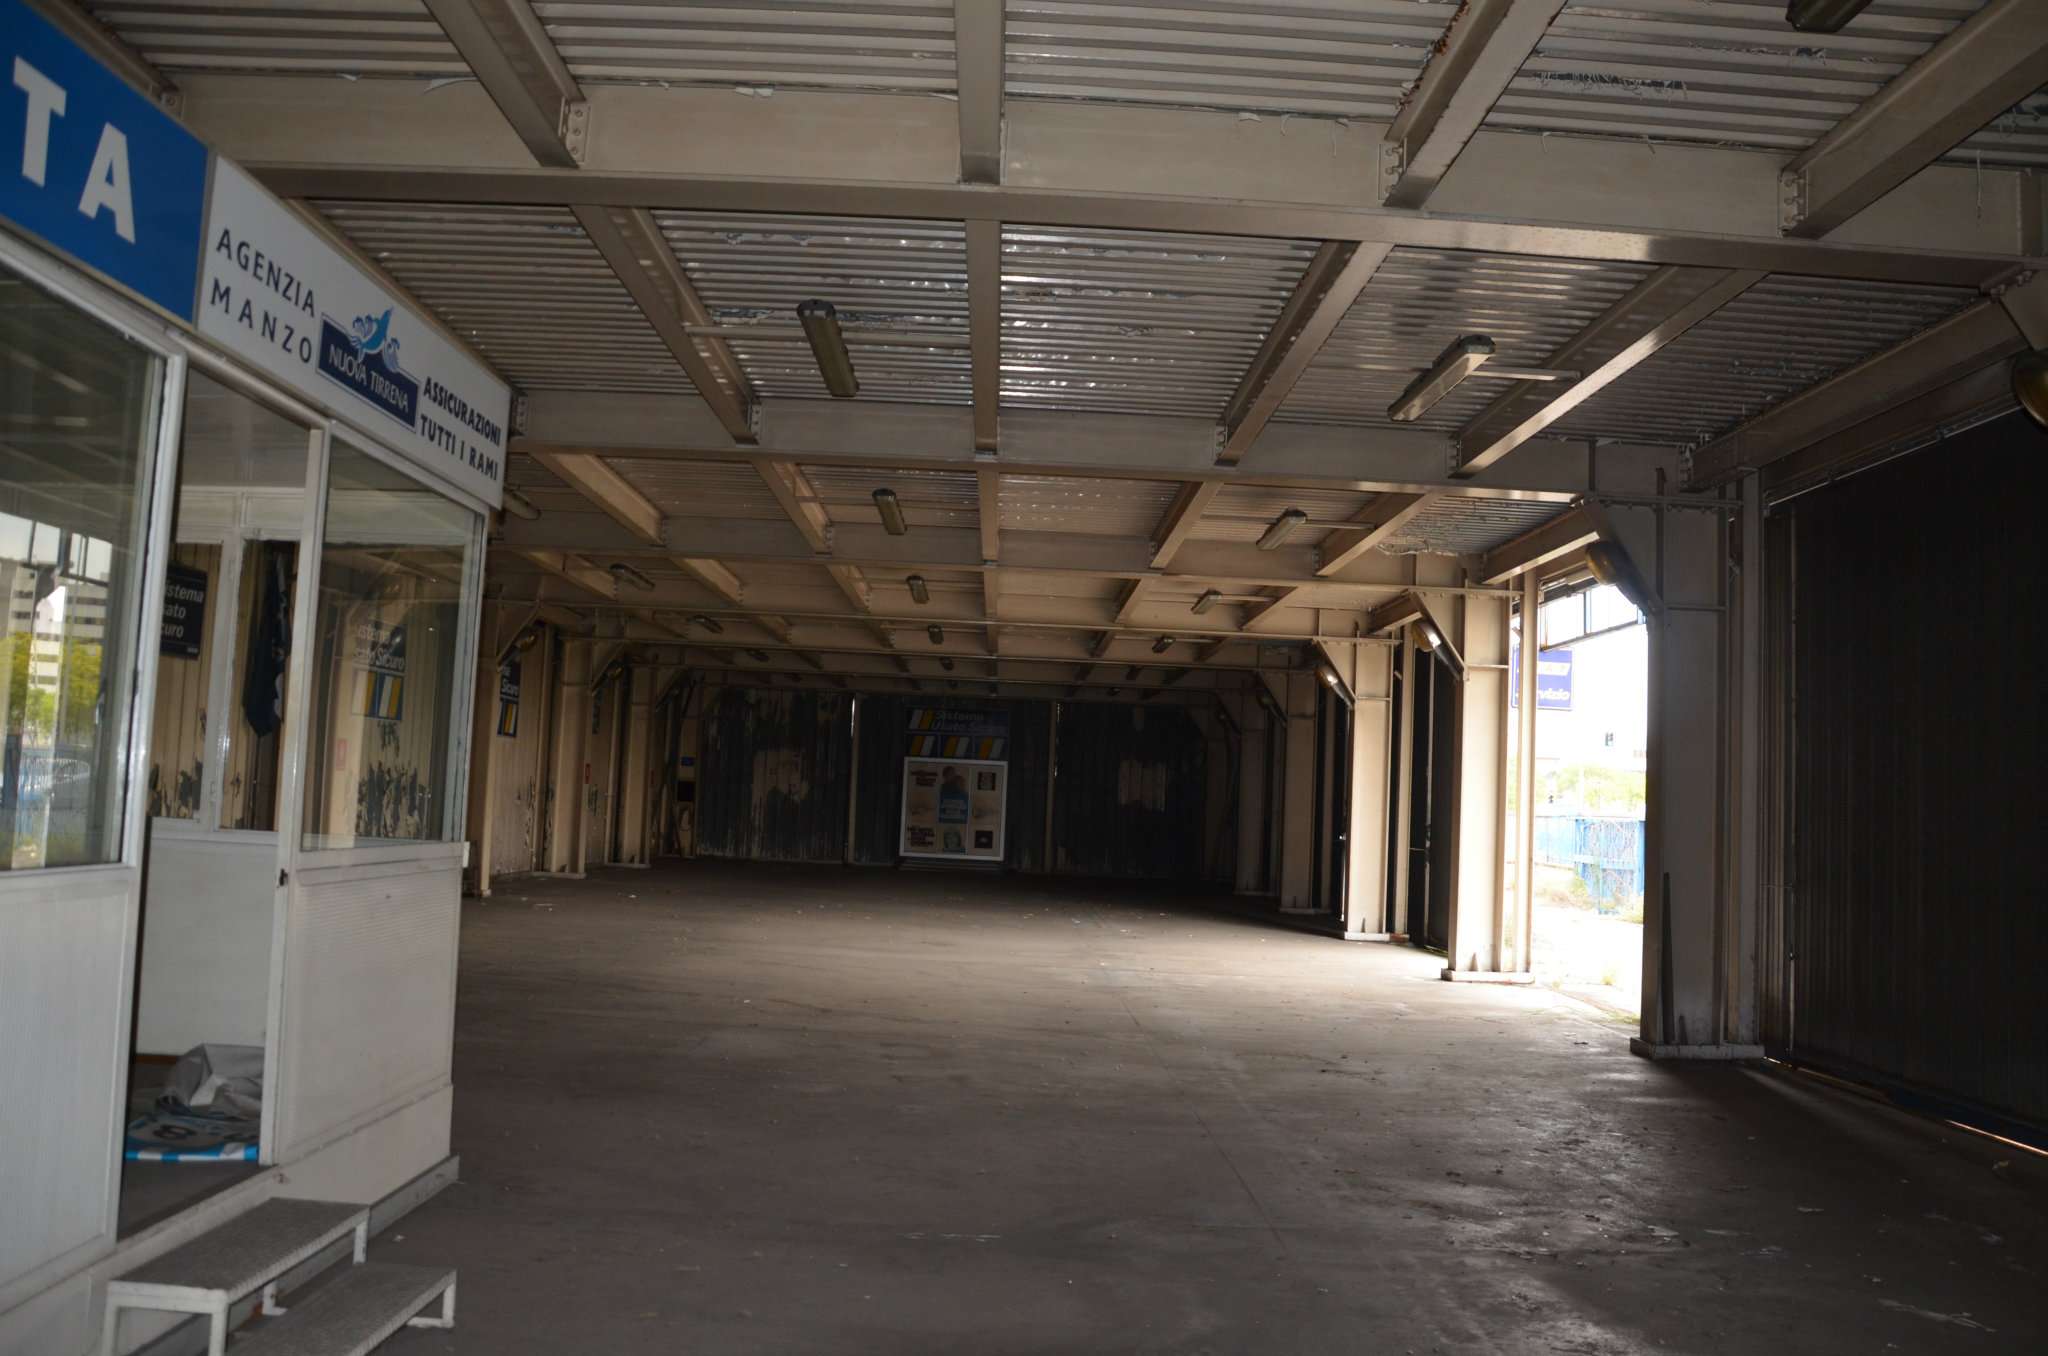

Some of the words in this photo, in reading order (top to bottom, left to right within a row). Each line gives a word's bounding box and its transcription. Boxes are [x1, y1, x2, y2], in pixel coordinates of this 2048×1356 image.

[216, 227, 315, 318] AGENZIA
[210, 277, 313, 363] MANZO
[328, 343, 368, 387] NUOVA
[370, 370, 409, 413] TIRRENA
[423, 376, 501, 447] ASSICURAZIONI
[420, 414, 456, 455] TUTTI
[459, 440, 465, 460] I
[468, 446, 498, 481] RAMI
[164, 603, 187, 619] ato
